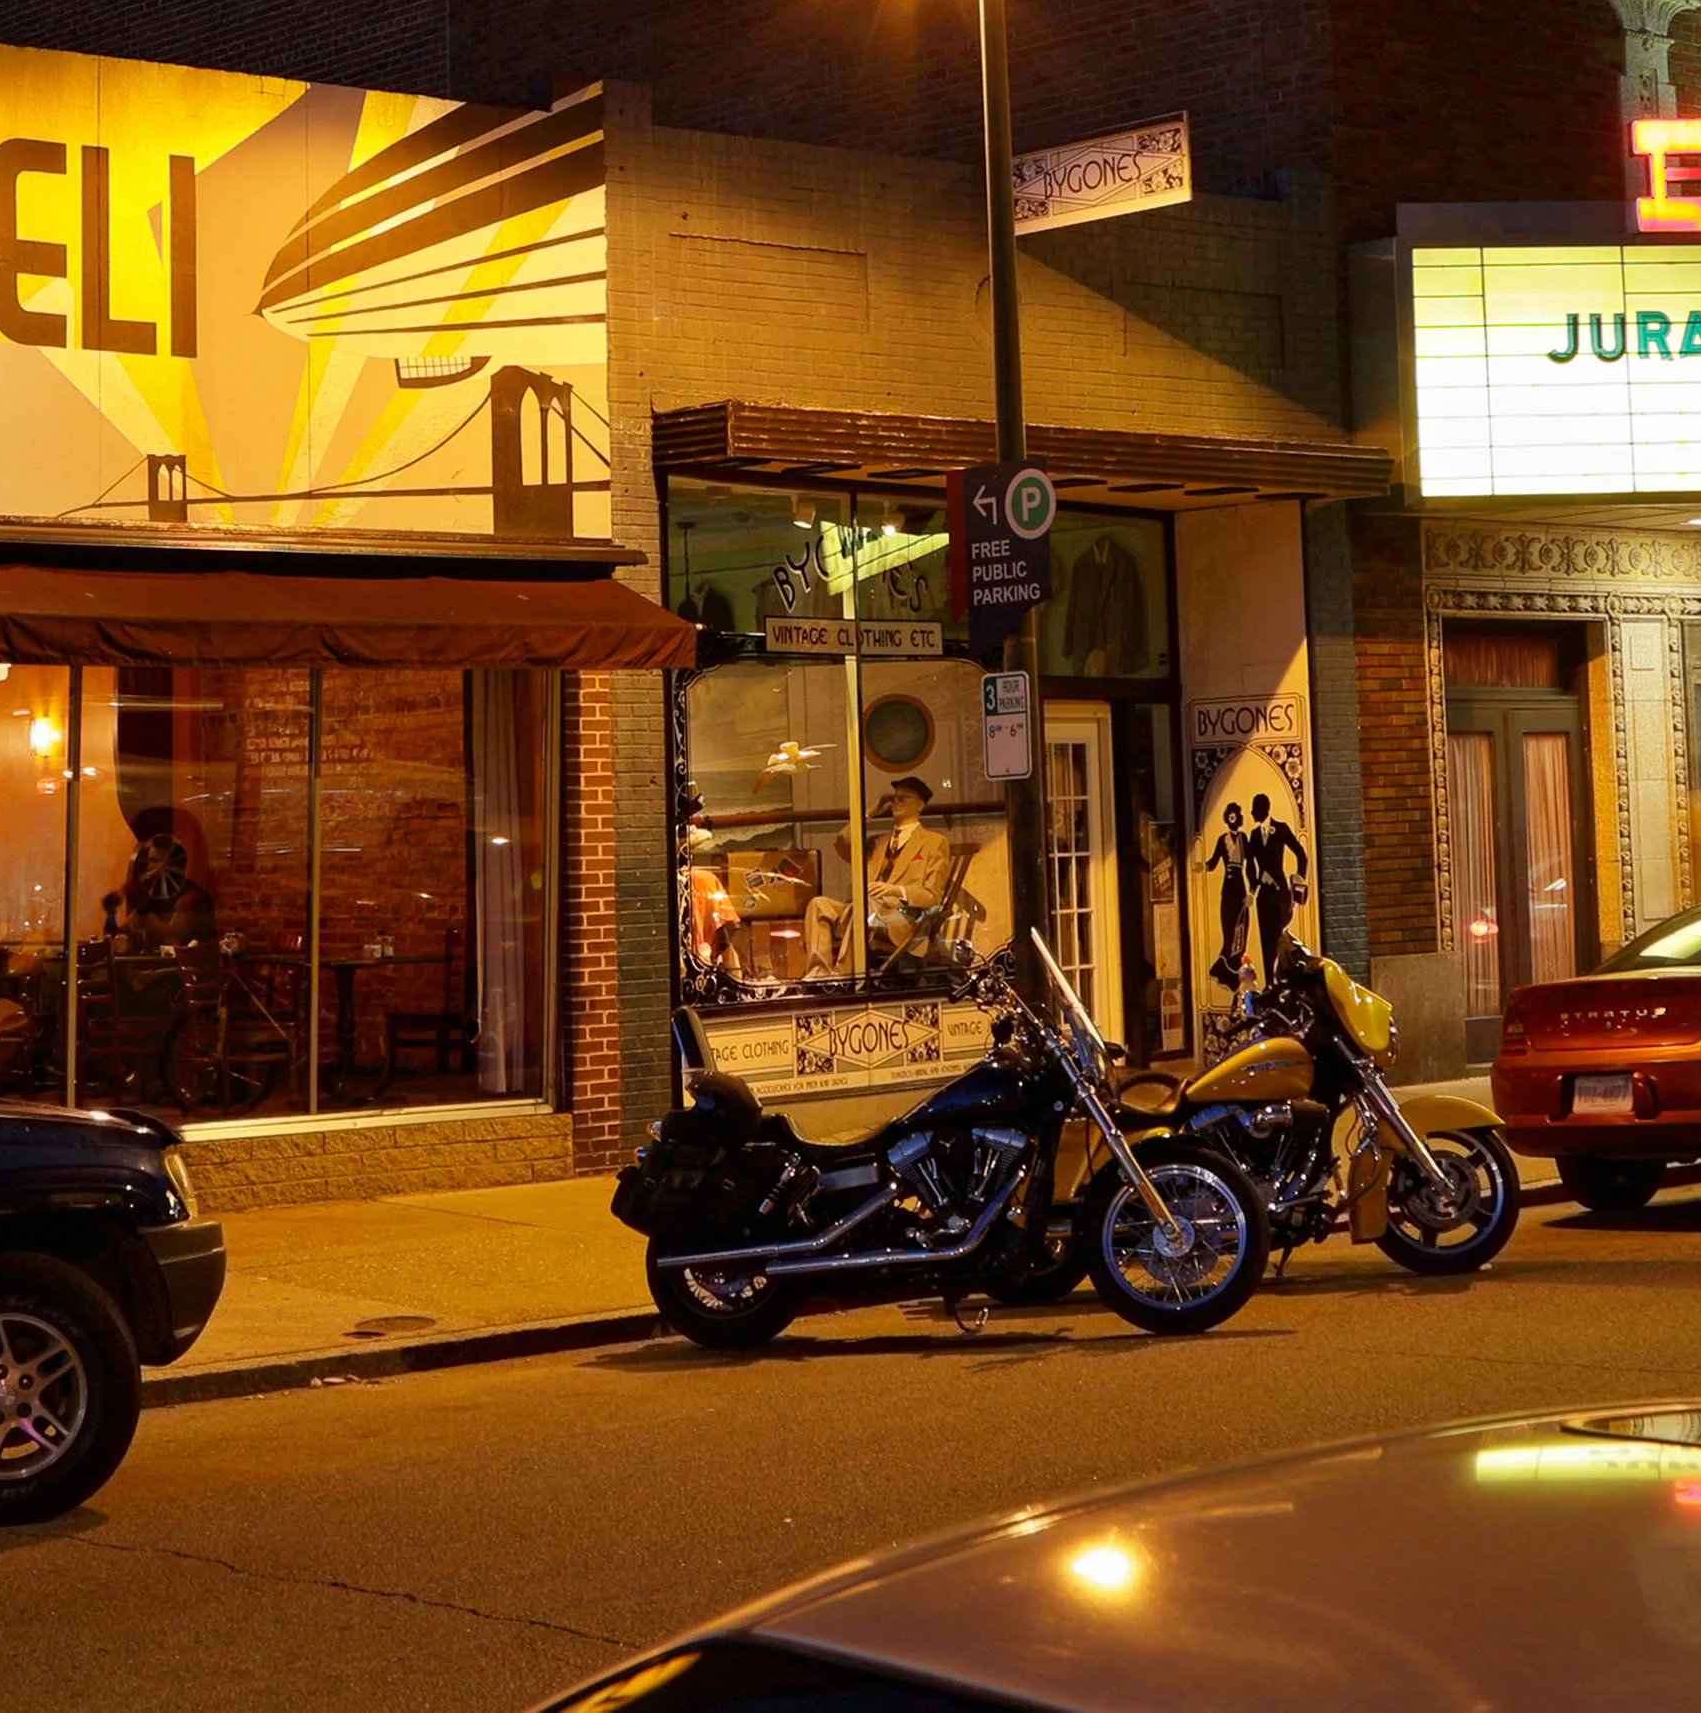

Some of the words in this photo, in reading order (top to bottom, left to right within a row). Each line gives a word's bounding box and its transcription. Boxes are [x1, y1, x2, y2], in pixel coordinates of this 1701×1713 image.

[1043, 151, 1143, 200] BYGONES
[971, 539, 1011, 559] FREE
[972, 561, 1027, 583] PUBLIC
[973, 583, 1041, 606] PARKING
[772, 626, 828, 646] VINTAGE
[837, 628, 903, 648] CLOTHING
[910, 629, 939, 648] ETC.
[986, 685, 996, 709] 3
[1002, 679, 1020, 692] HOUR
[999, 696, 1025, 708] PARKING
[1197, 703, 1295, 736] BYGONES
[828, 1019, 911, 1057] BYGONES
[947, 1020, 983, 1036] VINTAGE
[743, 1039, 789, 1060] CLOTHING
